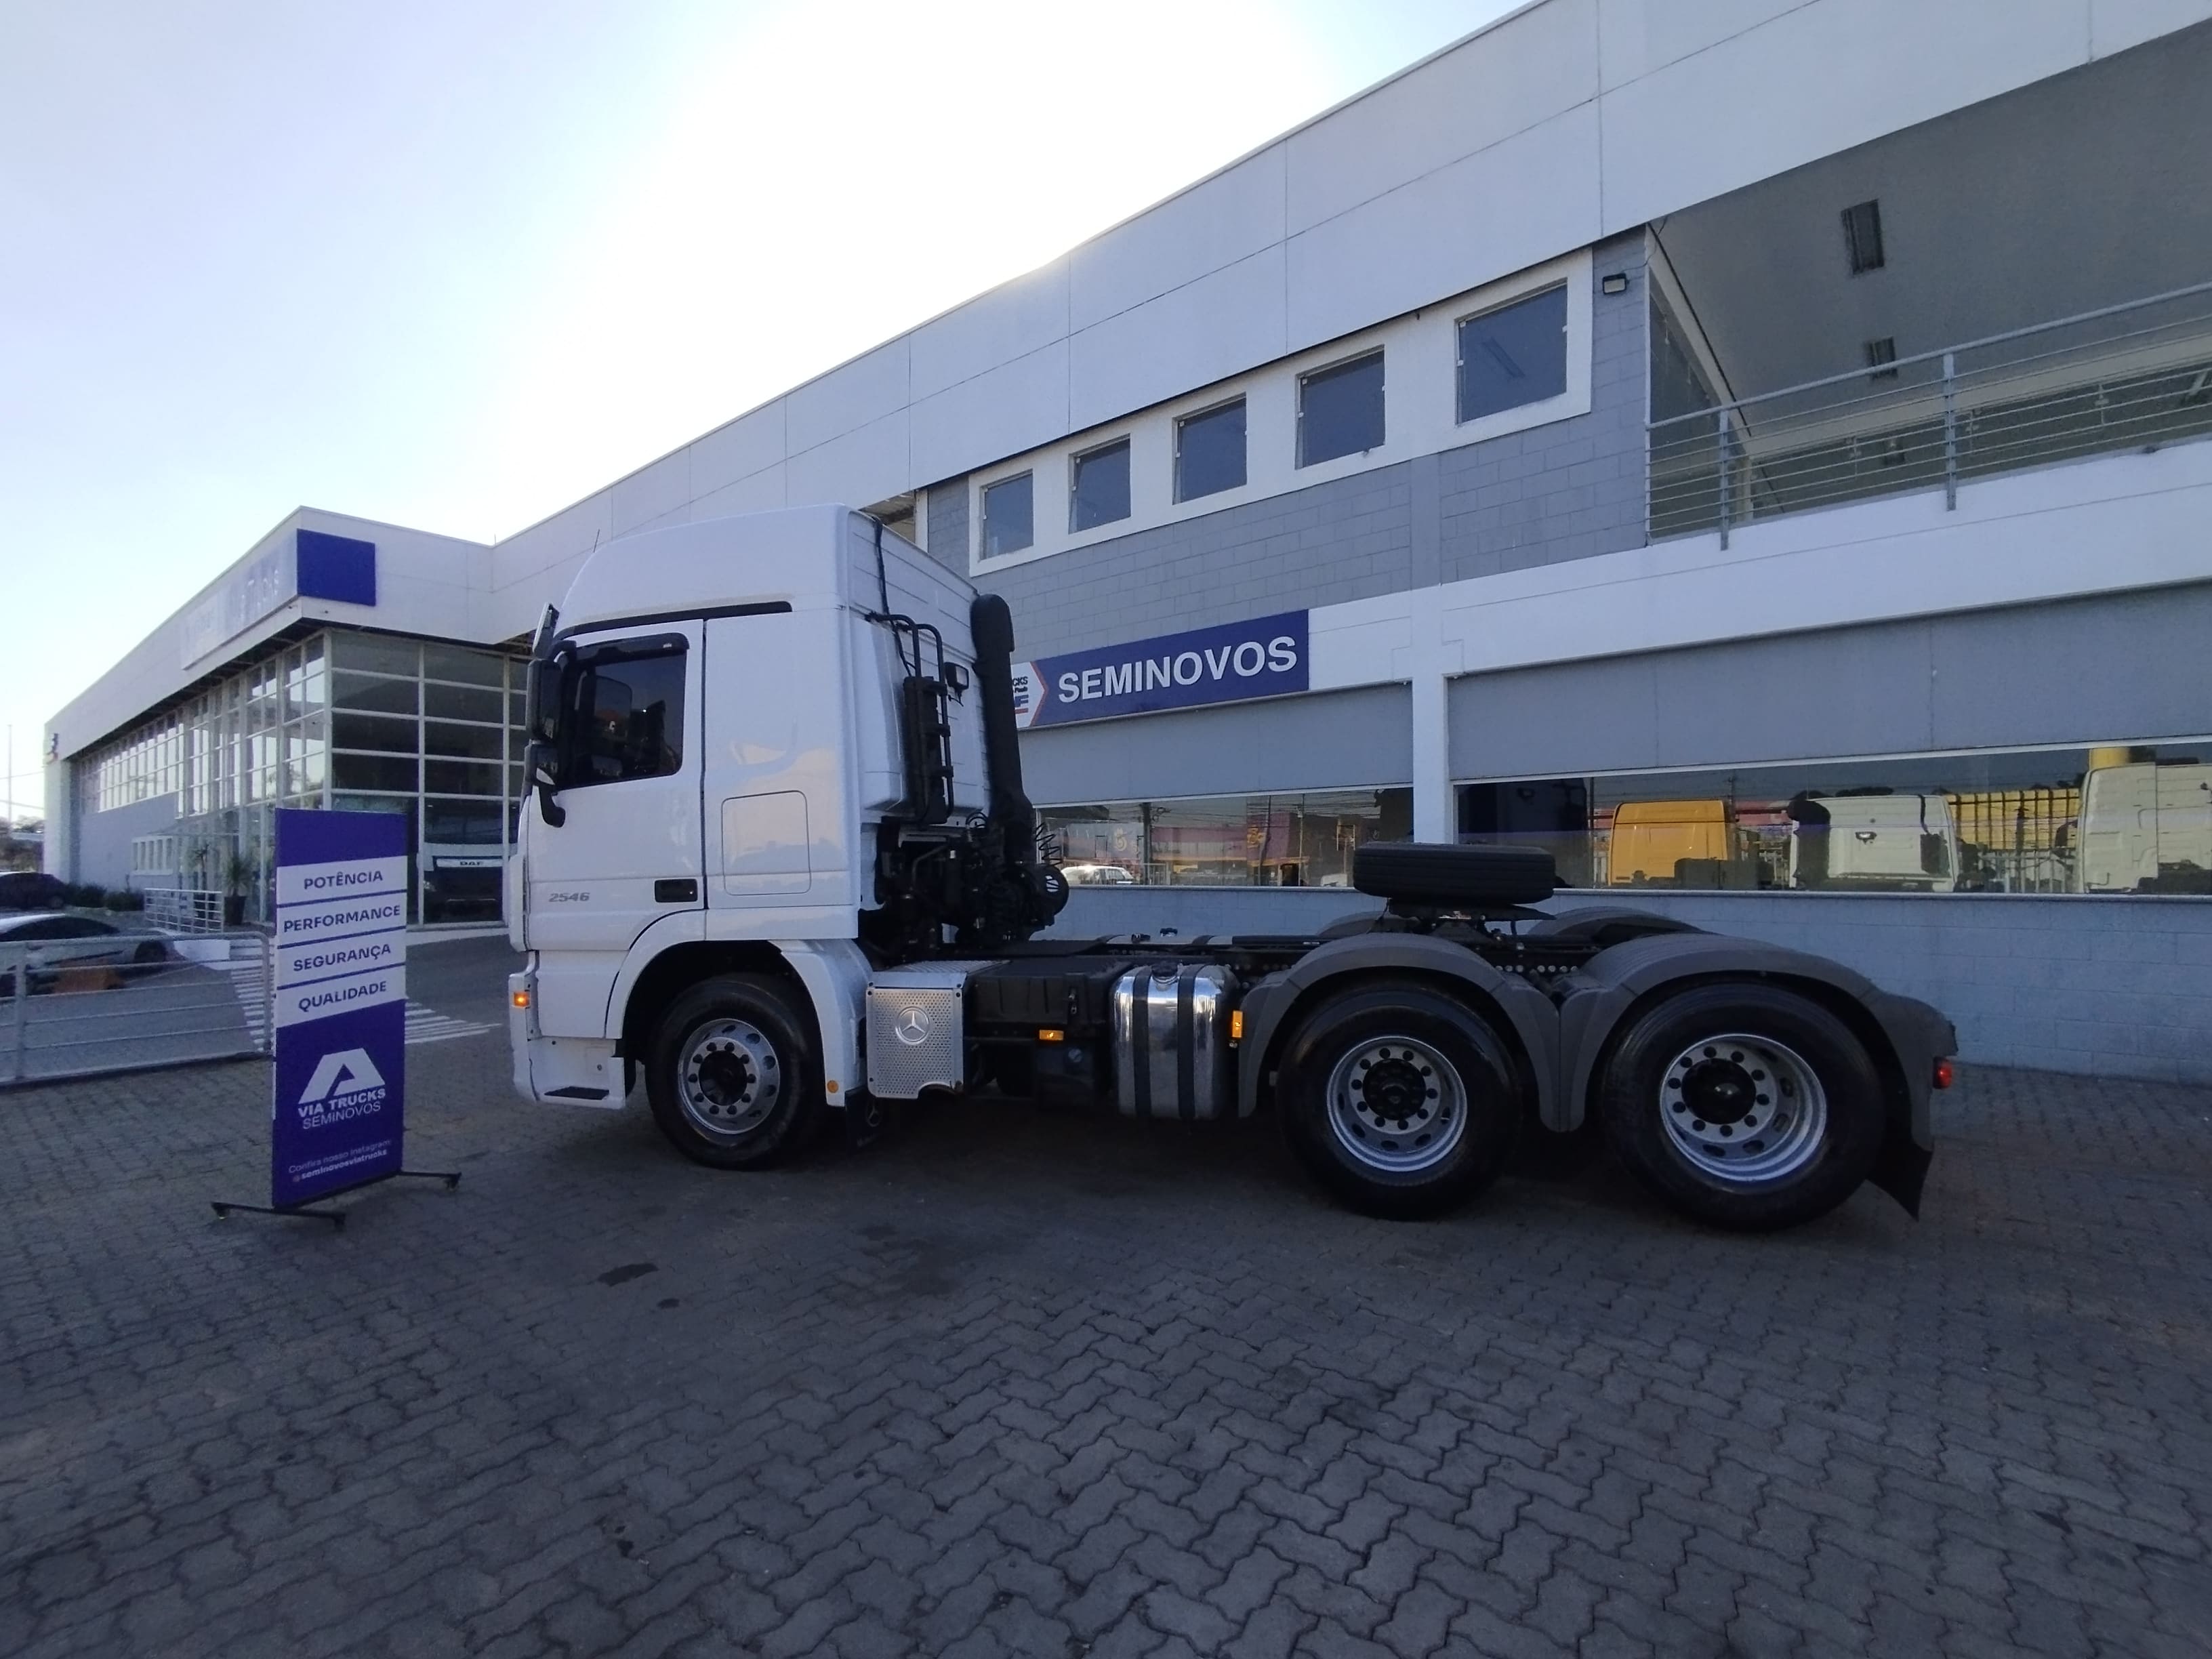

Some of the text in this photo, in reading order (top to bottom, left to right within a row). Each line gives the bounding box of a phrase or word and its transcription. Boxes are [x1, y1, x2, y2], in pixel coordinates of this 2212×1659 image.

[1058, 636, 1298, 703] SEMINOVOS
[304, 870, 384, 890] POTÊNCIA
[548, 892, 591, 903] 2546
[283, 905, 401, 933] PERFORMANCE
[293, 943, 392, 972] SEGURANÇA
[298, 981, 388, 1012] QUALIDADE
[298, 1088, 386, 1118] VIA TRUCKS
[302, 1101, 382, 1130] SEMINOVOS
